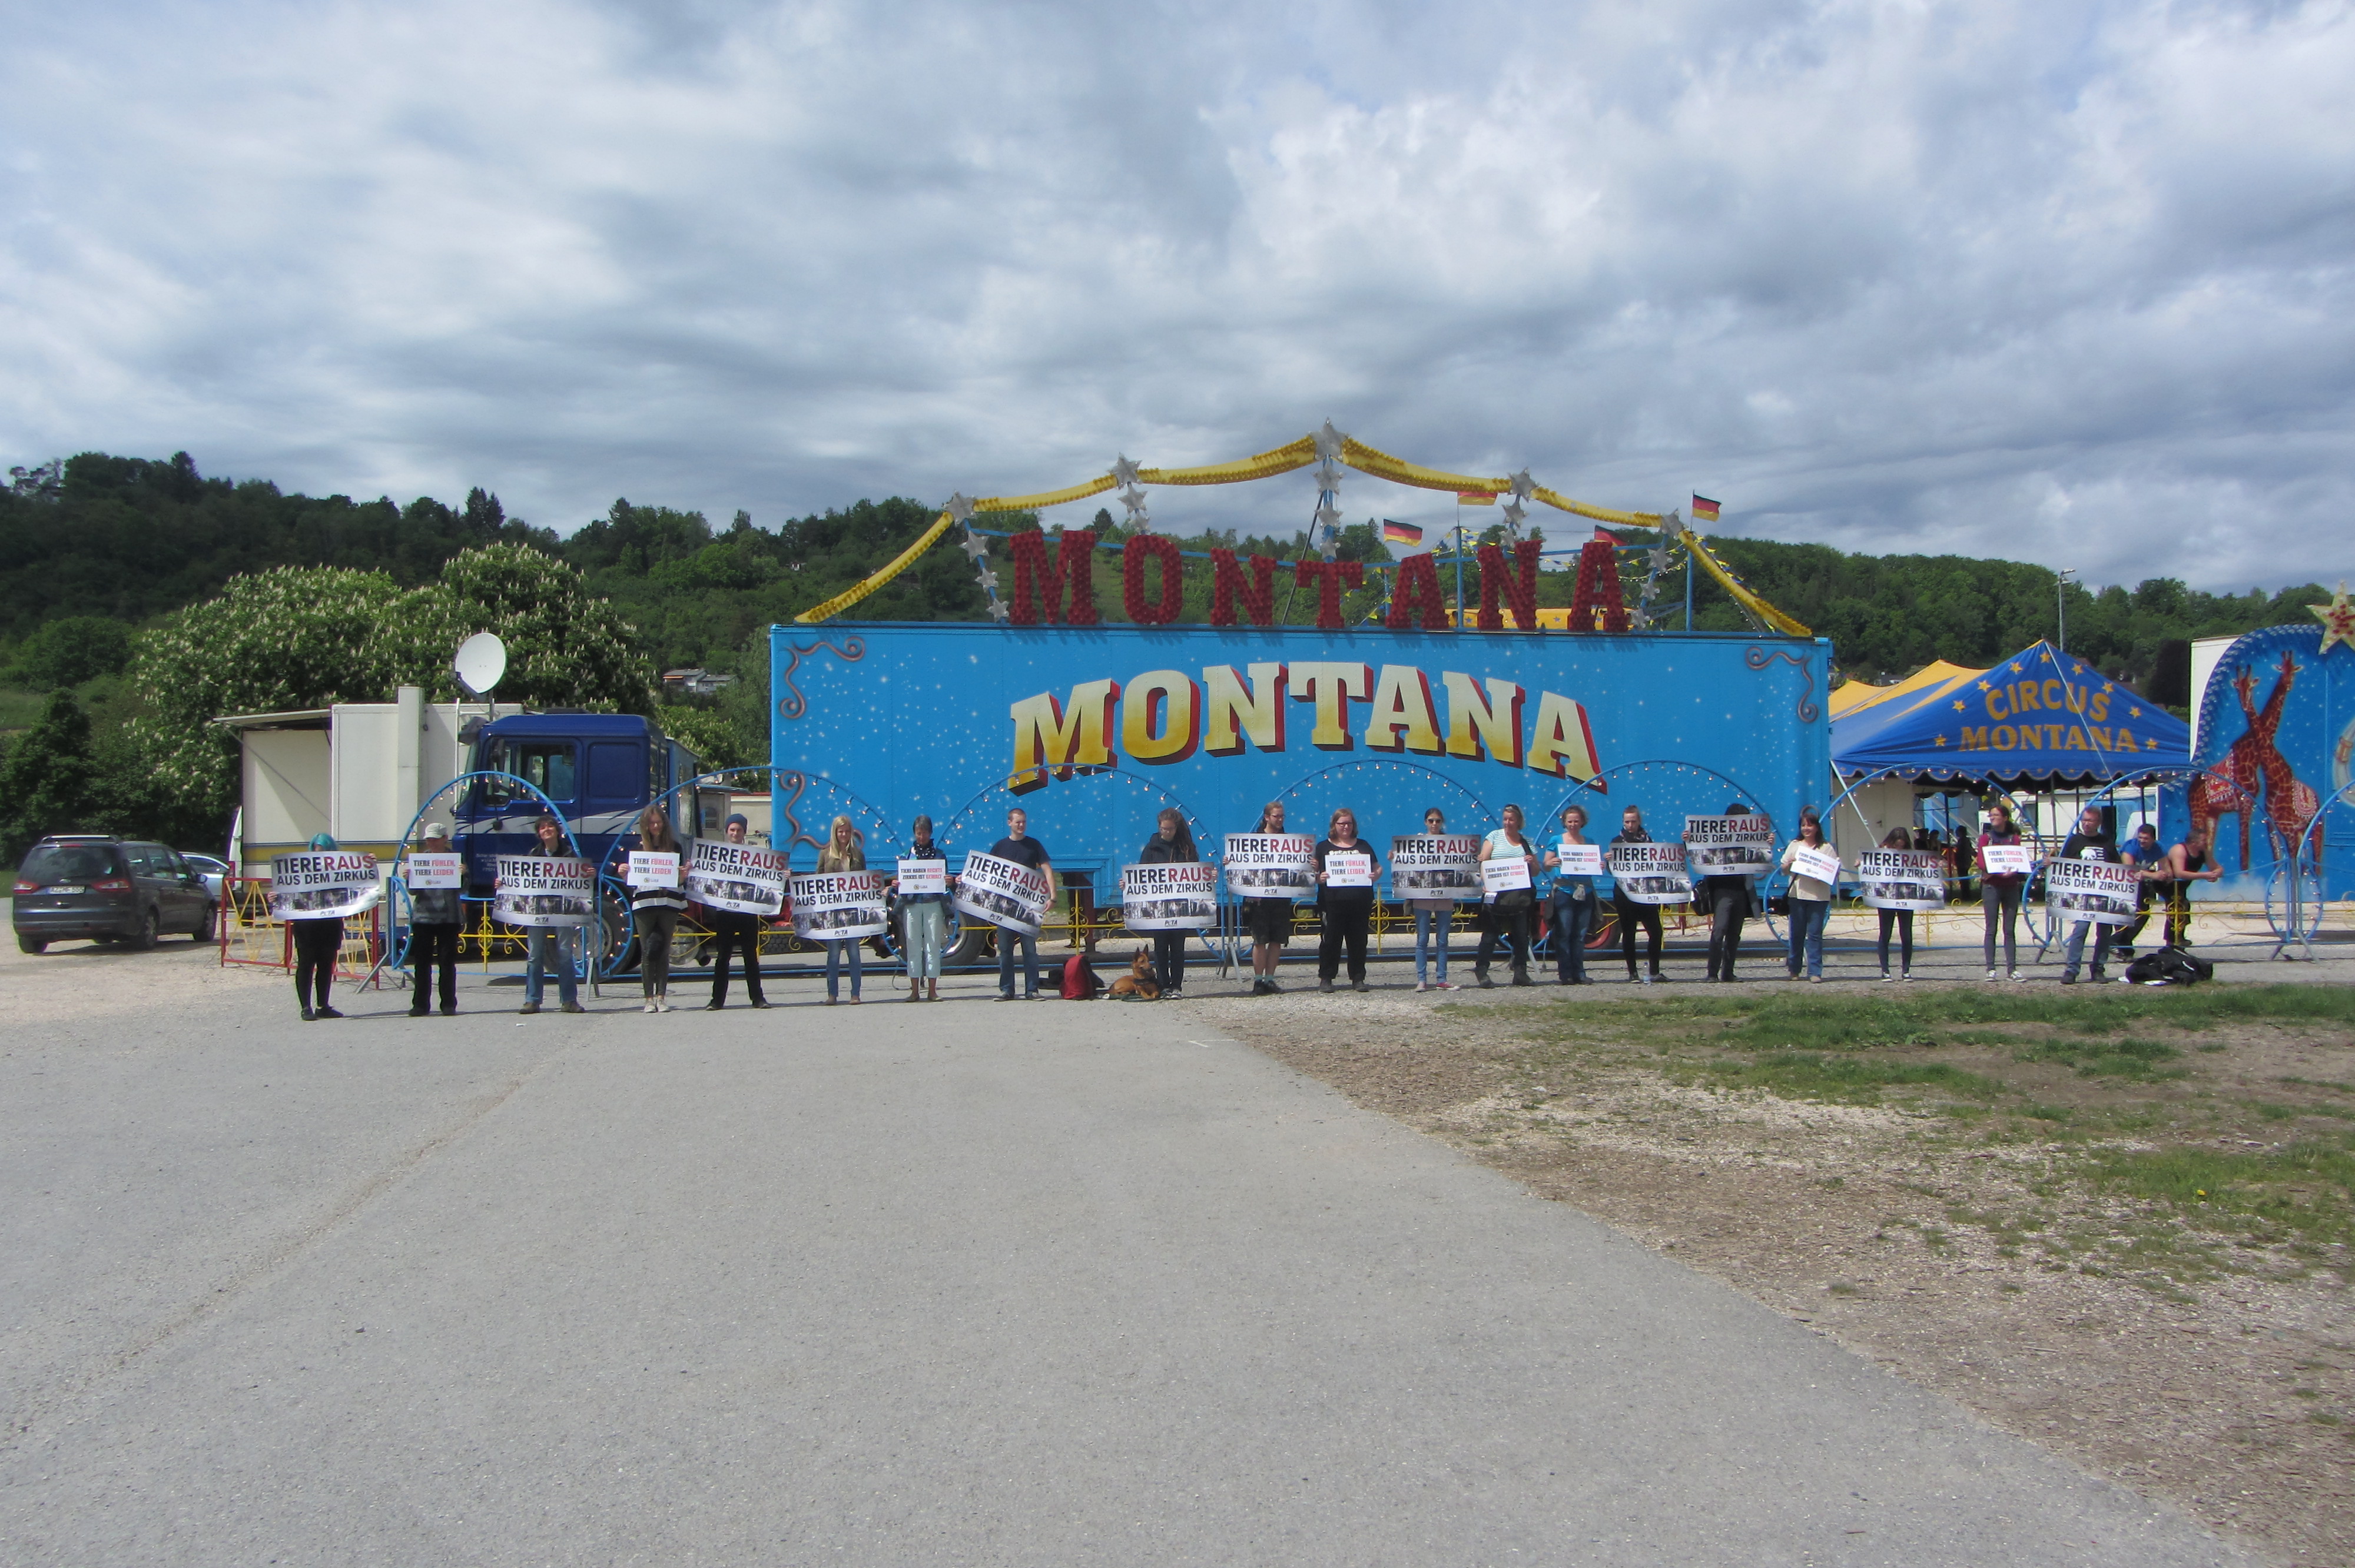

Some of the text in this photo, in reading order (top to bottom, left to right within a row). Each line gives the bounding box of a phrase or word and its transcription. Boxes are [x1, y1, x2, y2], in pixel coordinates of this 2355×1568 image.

[1009, 529, 1629, 632] MONTANA
[1986, 679, 2111, 722] CIRCUS
[1007, 661, 1607, 796] MONTANA
[1958, 724, 2140, 752] MONTANA
[1689, 832, 1768, 842] AUS DEM ZIRKUS
[1229, 854, 1312, 863] AUS DEM ZIRKUS
[1395, 855, 1478, 864] AUS DEM ZIRKUS
[694, 859, 783, 882] AUS DEM ZIRKUS
[1613, 862, 1685, 872] AUS DEM ZIRKUS
[1862, 866, 1939, 879] AUS DEM ZIRKUS
[277, 869, 375, 886] AUS DEM ZIRKUS
[501, 878, 589, 889] AUS DEM ZIRKUS
[966, 870, 1046, 905] AUS DEM ZIRKUS
[1126, 882, 1212, 895] AUS DEM ZIRKUS
[2050, 878, 2135, 893] AUS DEM ZIRKUS
[795, 890, 882, 906] AUS DEM ZIRKUS
